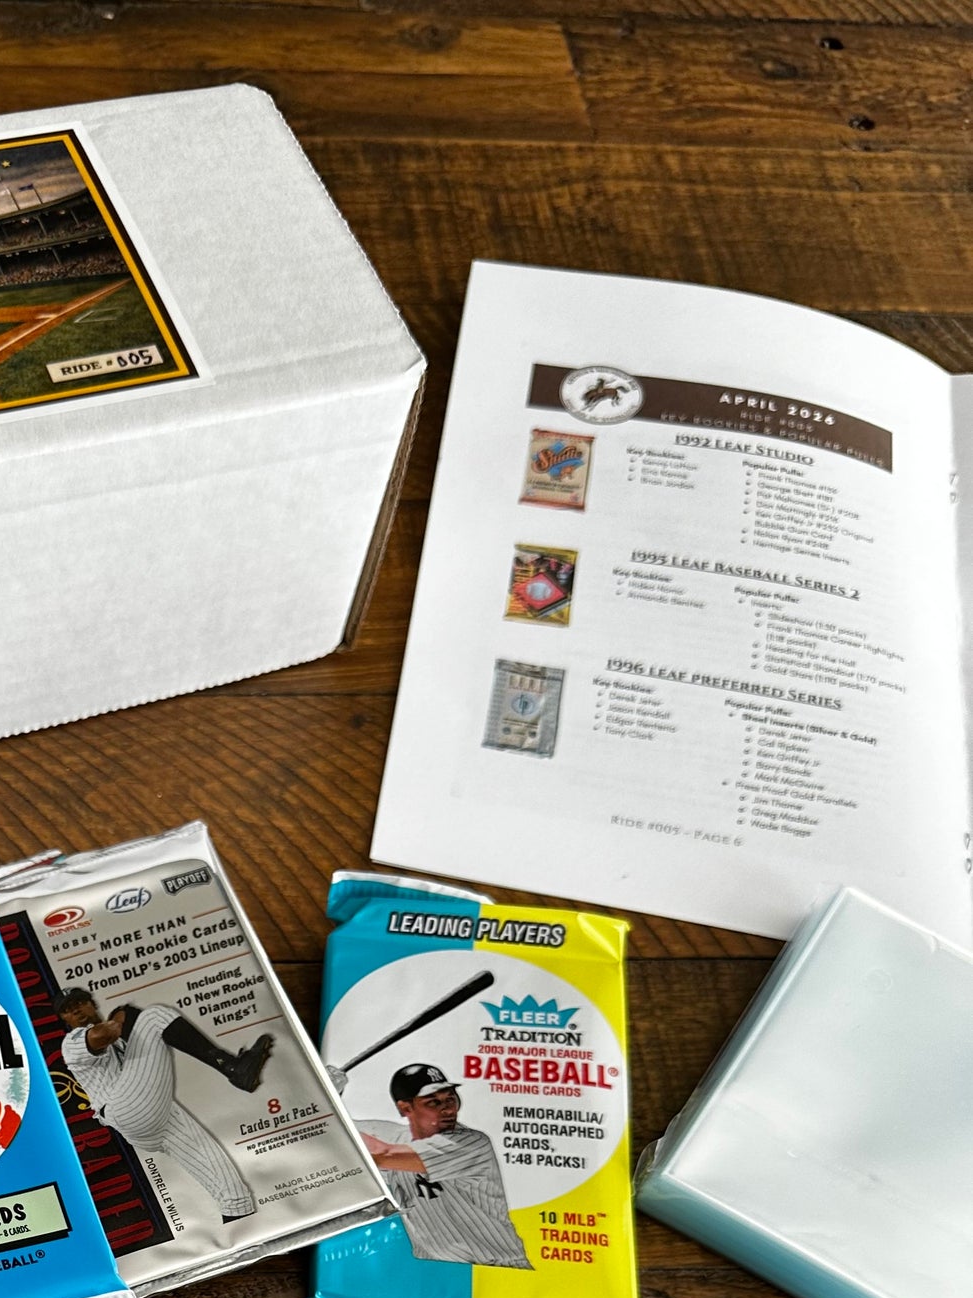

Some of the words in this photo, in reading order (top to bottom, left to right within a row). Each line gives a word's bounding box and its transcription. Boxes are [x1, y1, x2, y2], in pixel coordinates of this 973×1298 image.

[61, 362, 102, 376] RIDE
[720, 392, 779, 413] APRIL
[787, 406, 836, 426] 2026
[674, 433, 711, 447] 1992
[715, 438, 751, 454] LEAF
[755, 445, 814, 467] STUDIO
[671, 556, 709, 574] LEAF
[714, 563, 790, 586] BASEBALL
[794, 574, 846, 598] SERIES
[649, 664, 687, 683] LEAF
[691, 673, 783, 698] PREFERRED
[787, 687, 842, 711] SERIES
[165, 870, 208, 891] PLAYOFF
[99, 931, 143, 950] MORE
[147, 916, 187, 937] THAN
[389, 914, 472, 938] LEADING
[477, 920, 565, 946] PLAYERS
[52, 933, 98, 953] HOBBY
[65, 962, 93, 980] 200
[97, 953, 130, 971] New
[135, 934, 188, 959] Rookie
[193, 917, 237, 940] Cards
[88, 974, 120, 992] from
[123, 959, 161, 981] DLP's
[164, 948, 197, 967] 2003
[200, 934, 245, 958] Lineup
[499, 1010, 560, 1025] FLEER
[481, 1027, 581, 1046] TRADITION
[478, 1045, 504, 1055] 2003
[508, 1047, 547, 1057] MAJOR
[550, 1049, 593, 1061] LEAGUE
[267, 1098, 281, 1114] 8
[503, 1107, 604, 1125] MEMORABILIA/
[239, 1114, 271, 1136] Cards
[274, 1114, 291, 1129] per
[293, 1102, 320, 1120] Pack
[503, 1122, 605, 1140] AUTOGRAPHED
[503, 1137, 554, 1153] CARDS,
[504, 1153, 532, 1165] 1:48
[536, 1155, 585, 1169] PACKS!
[144, 1158, 175, 1205] DONTRELLE
[167, 1200, 185, 1232] WILLIS
[540, 1229, 609, 1246] TRADING
[541, 1247, 594, 1263] CARDS
